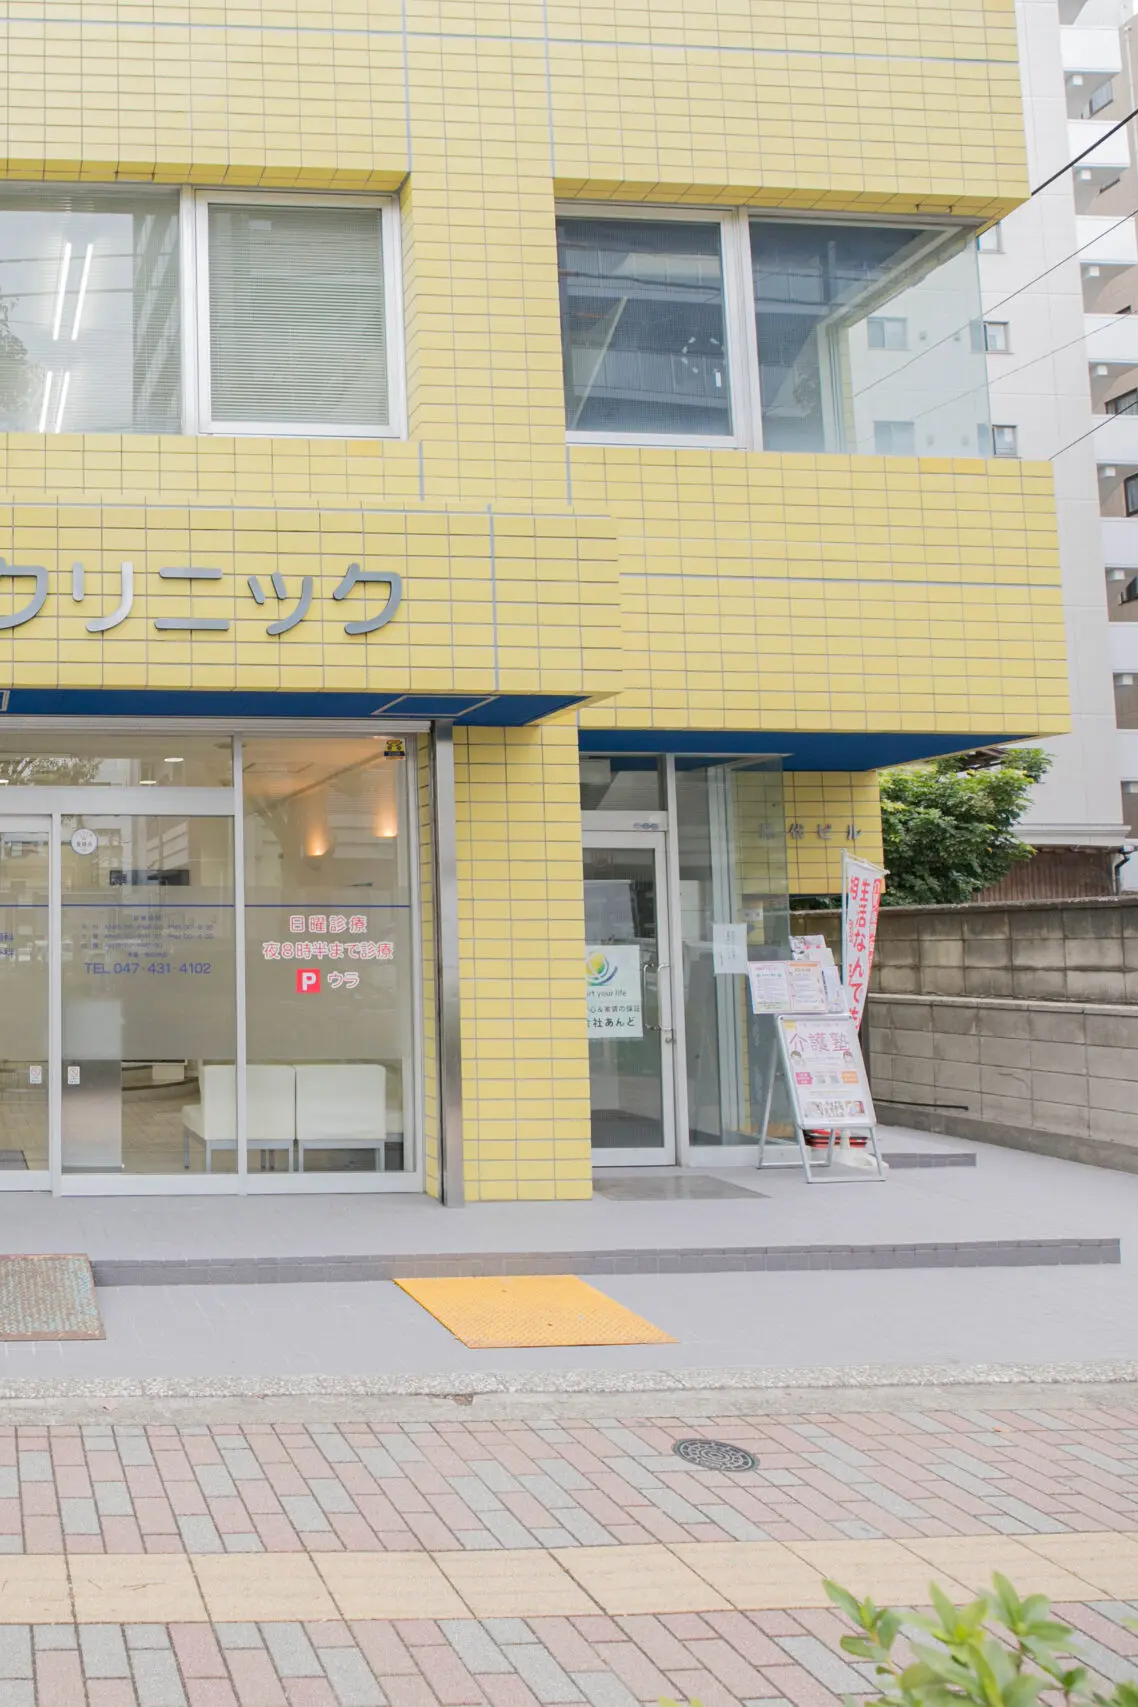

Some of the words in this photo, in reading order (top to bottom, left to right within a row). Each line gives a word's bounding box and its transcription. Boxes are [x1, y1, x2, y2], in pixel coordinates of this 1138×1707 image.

[289, 915, 367, 933] 日曜診療
[262, 941, 394, 960] 夜8時半まで診療
[84, 962, 110, 974] TEL
[327, 971, 360, 988] ウラ
[587, 1017, 635, 1028] 社あんど
[789, 1032, 852, 1052] 介護塾
